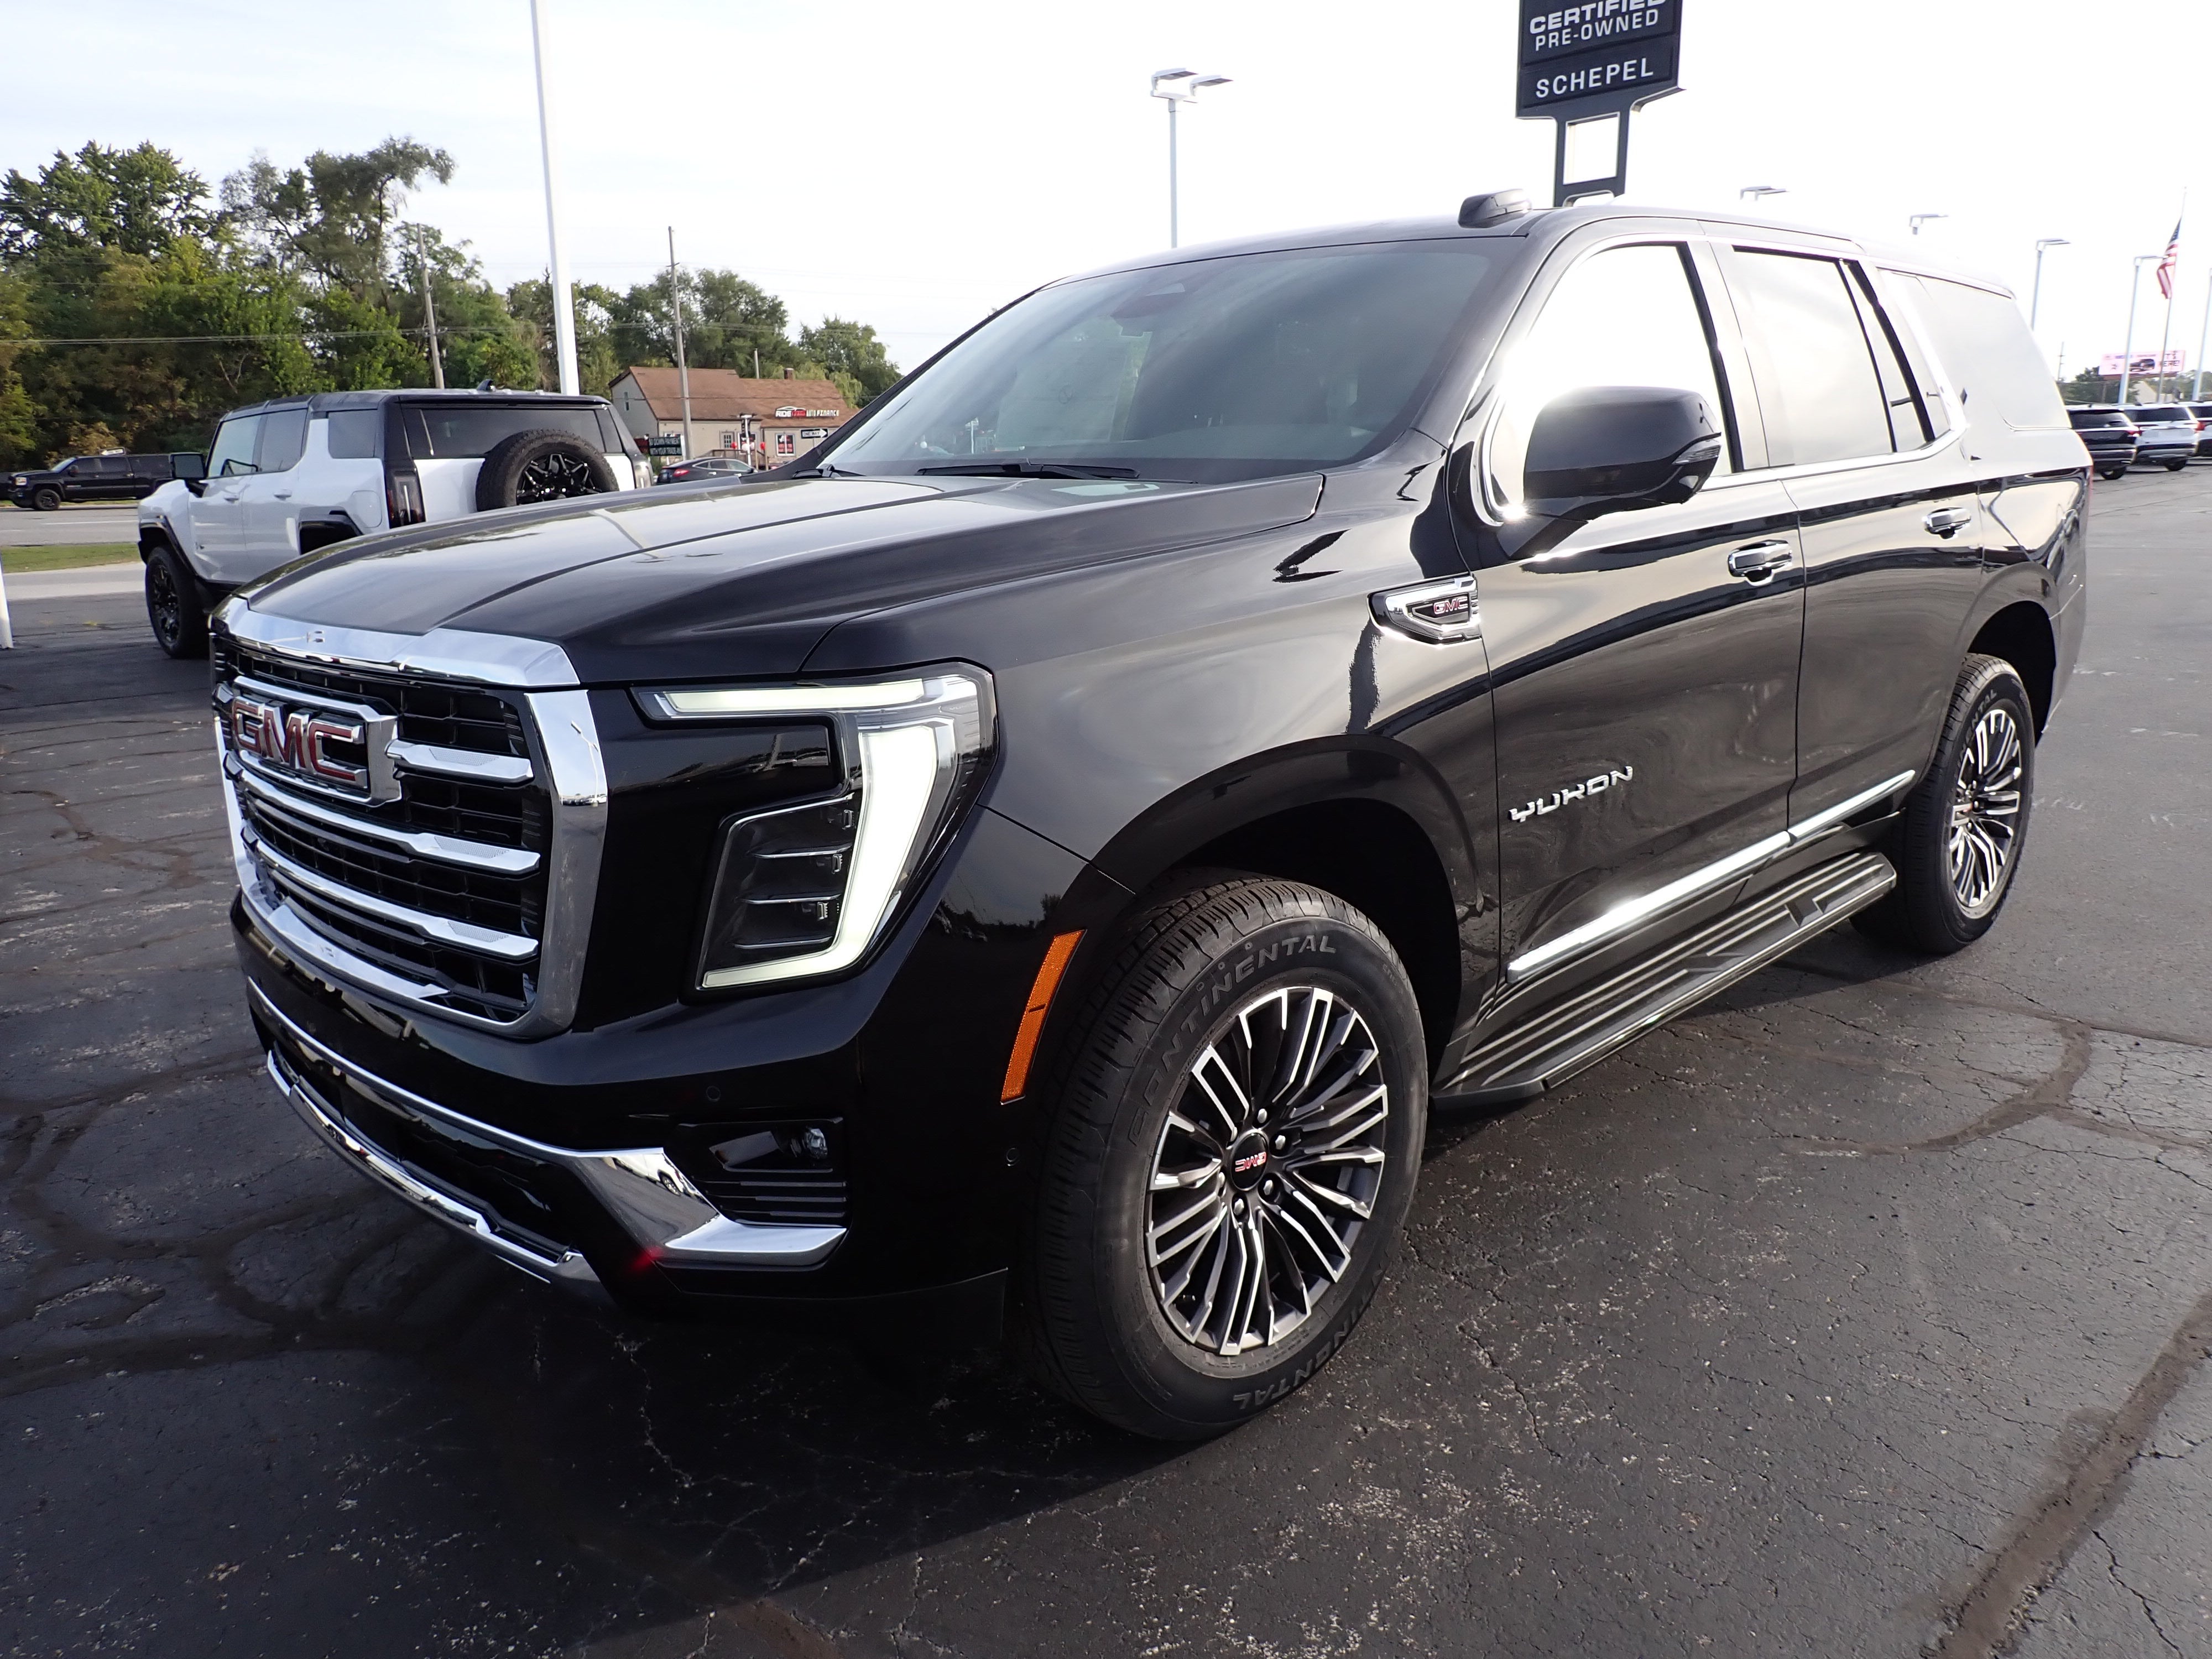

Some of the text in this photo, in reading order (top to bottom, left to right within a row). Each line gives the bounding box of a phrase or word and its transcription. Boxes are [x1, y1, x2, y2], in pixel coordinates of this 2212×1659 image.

[1536, 9, 1658, 51] PRE-OWNED
[1536, 58, 1653, 98] SCHEPEL
[1433, 596, 1468, 615] GMC
[233, 696, 368, 789] GMC
[1509, 766, 1633, 822] YUKON
[1128, 935, 1337, 1147] CONTINENTAL
[1235, 1151, 1266, 1172] GMC
